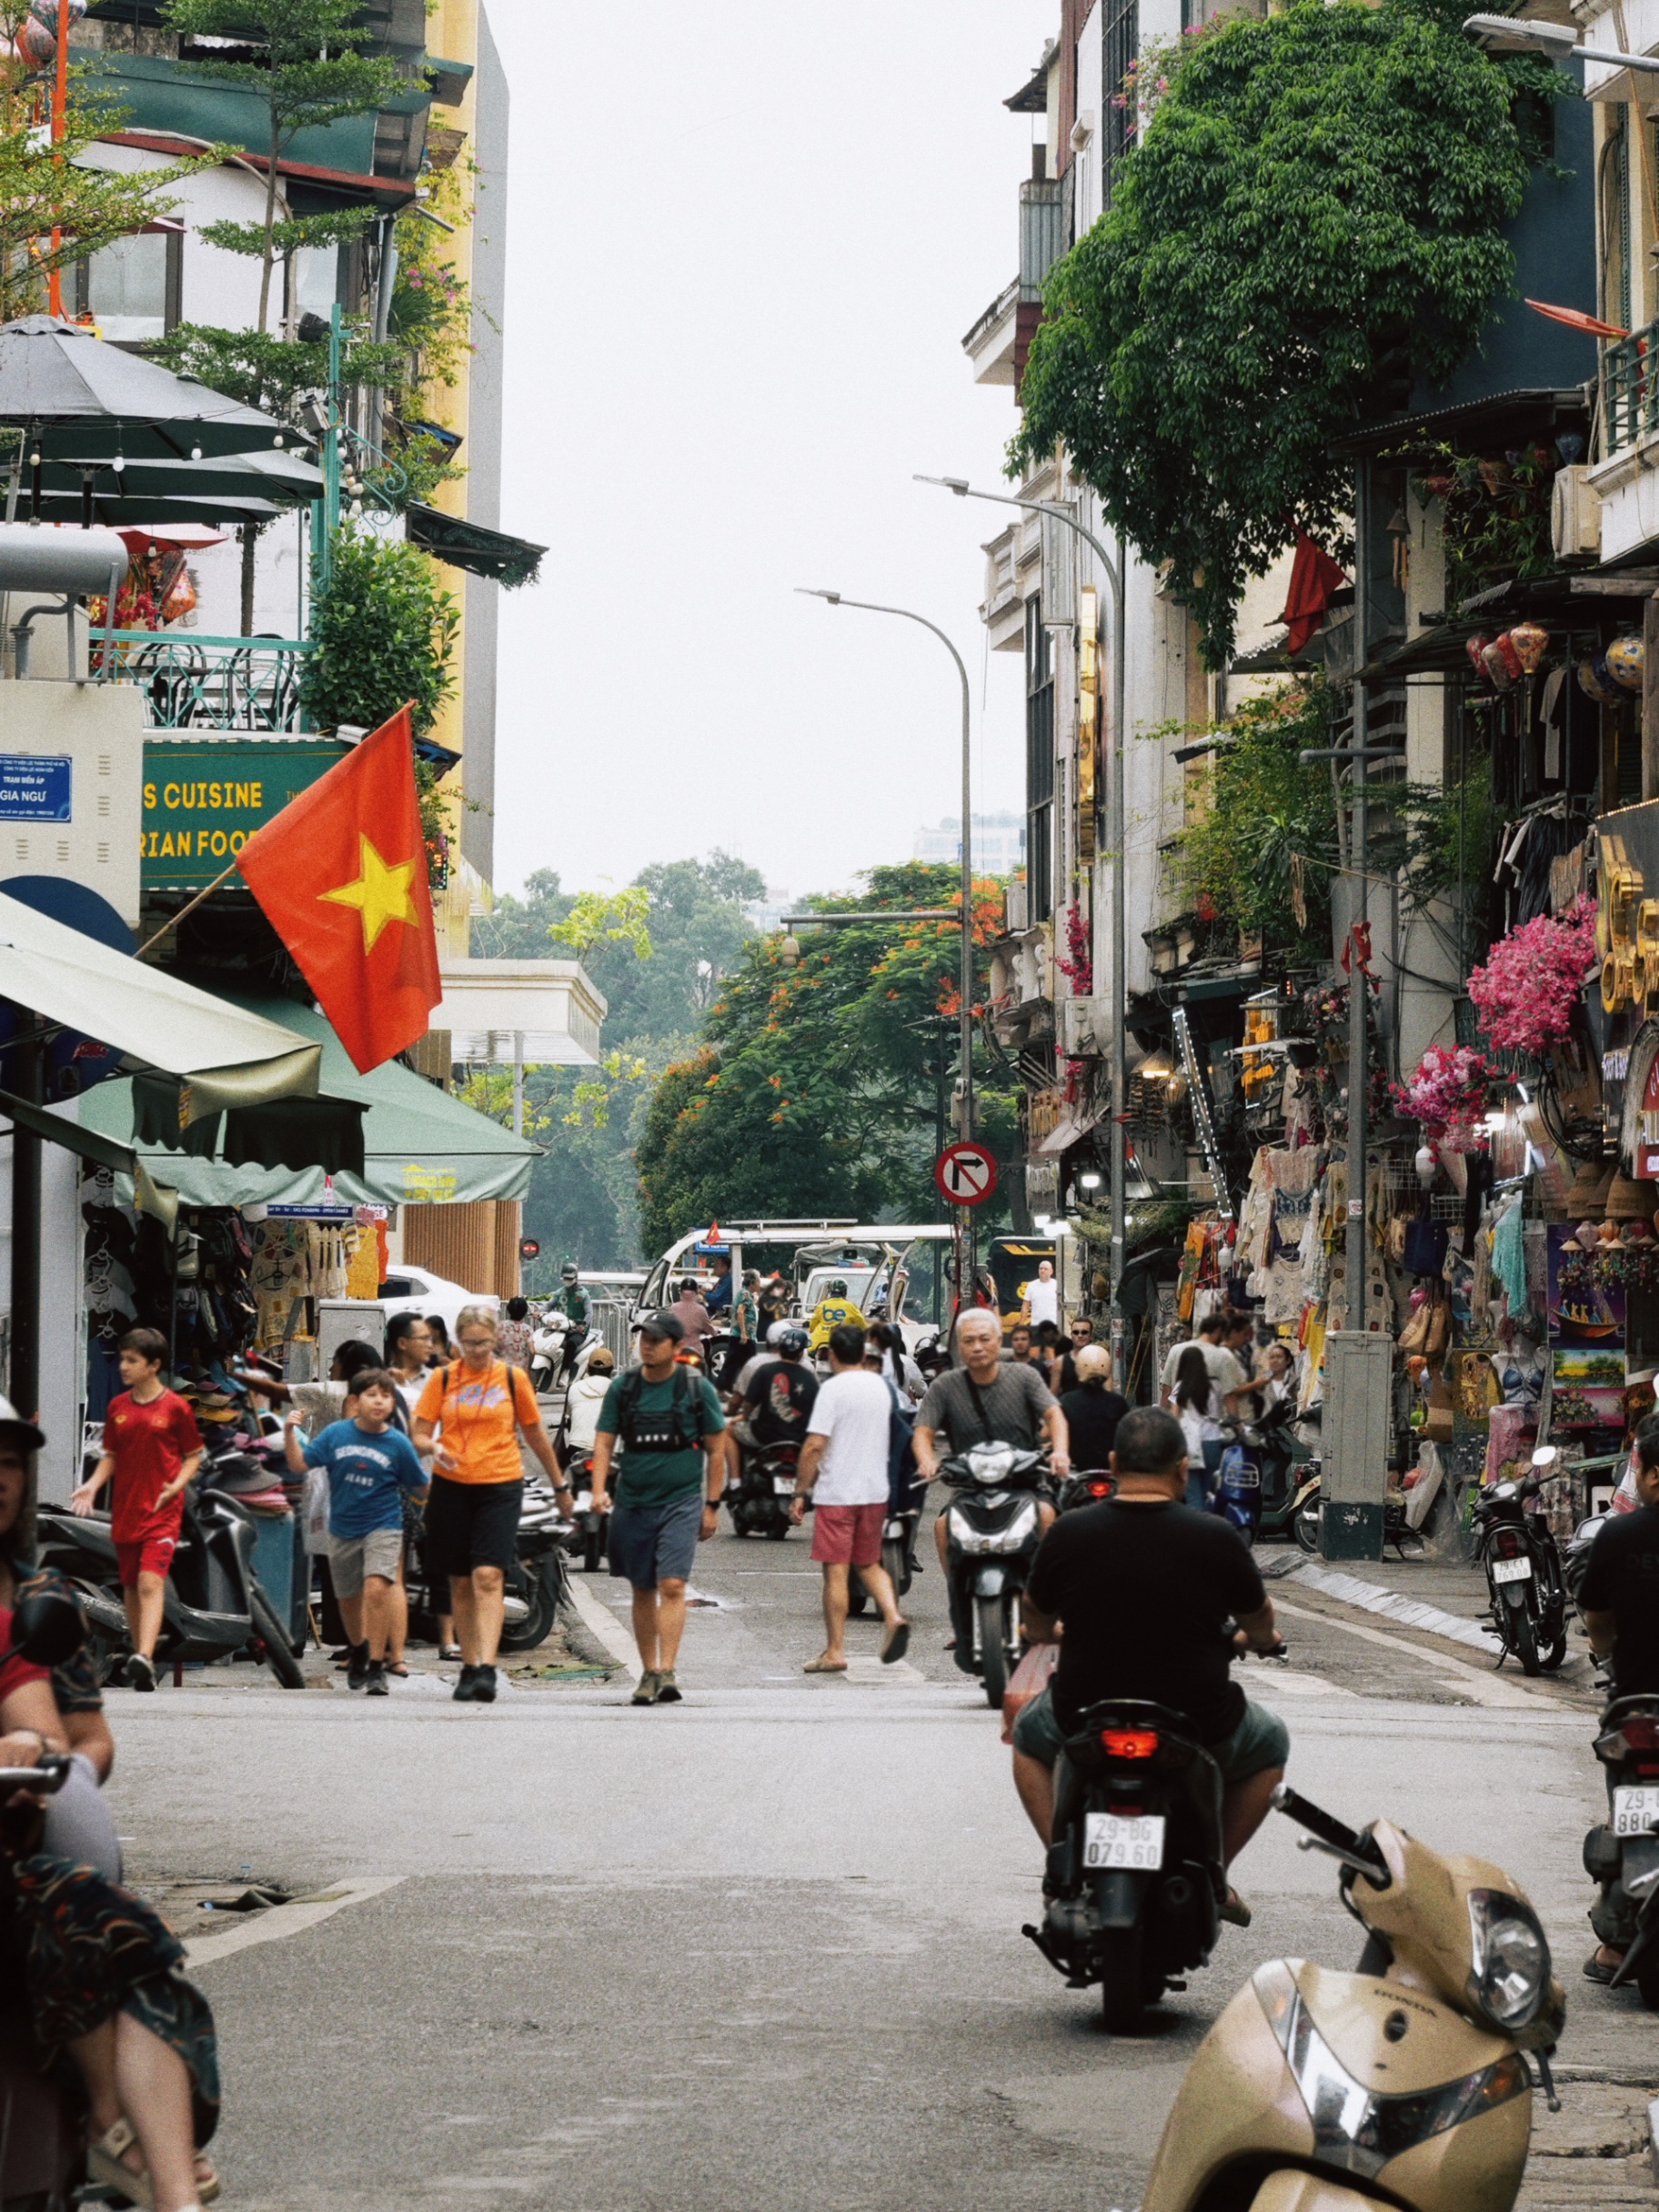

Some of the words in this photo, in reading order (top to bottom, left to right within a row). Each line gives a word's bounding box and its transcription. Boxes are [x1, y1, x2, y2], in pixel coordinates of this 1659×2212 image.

[0, 789, 19, 801] GIA
[21, 790, 46, 802] NGƯ
[143, 782, 157, 809] S
[164, 781, 262, 809] CUISINE
[822, 1304, 847, 1322] be
[1373, 1988, 1438, 2017] HONDA
